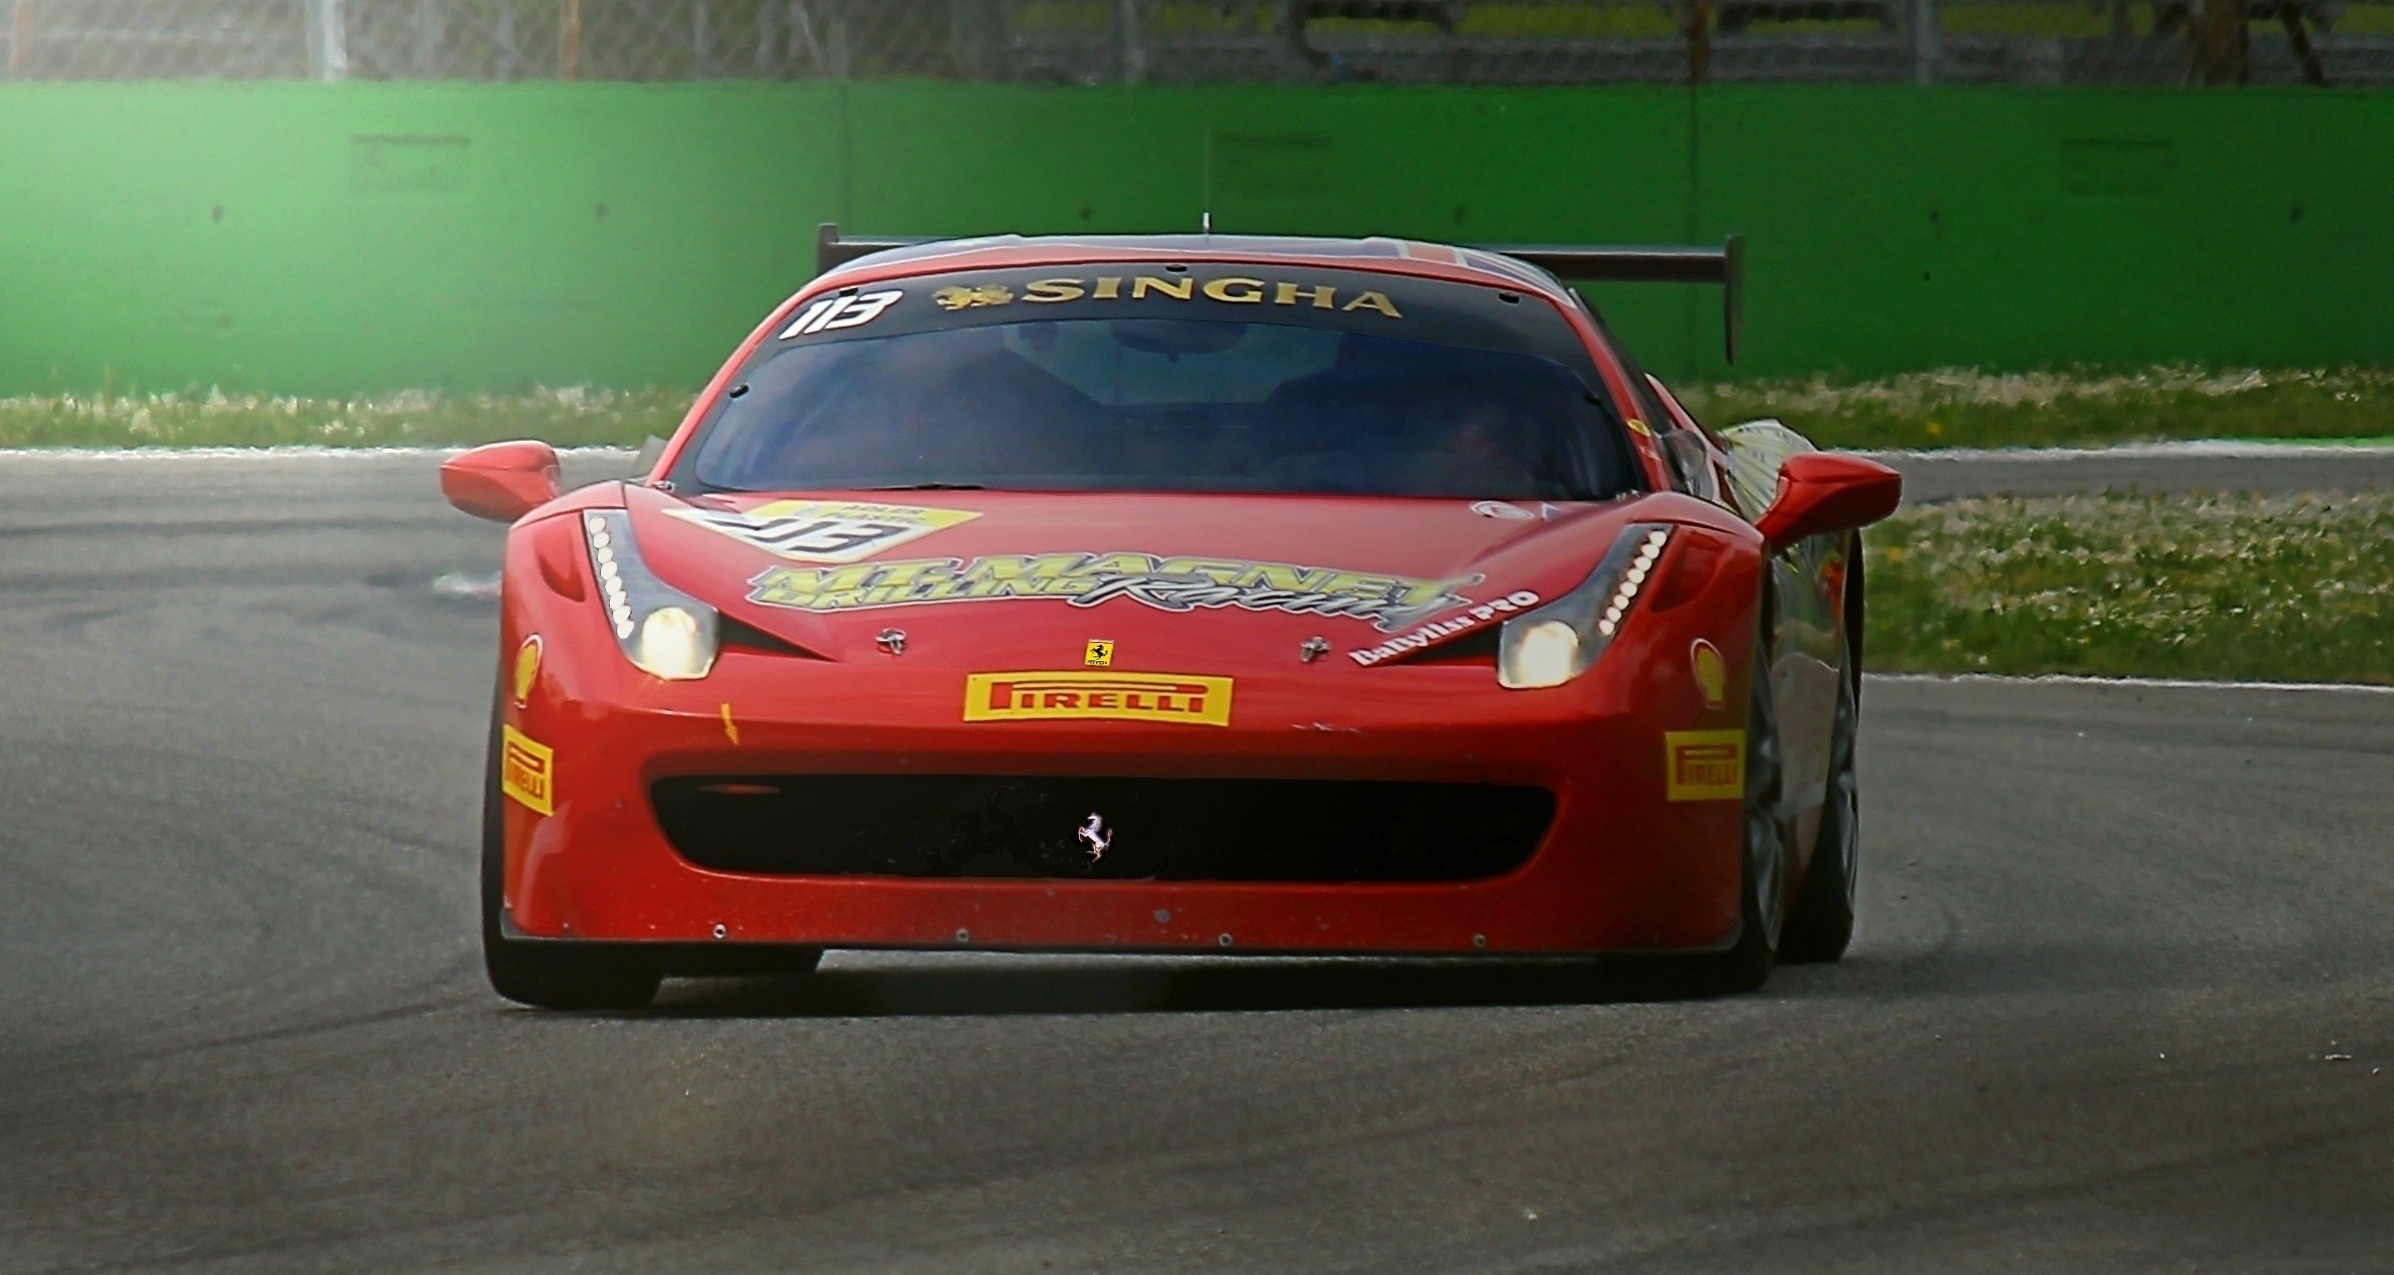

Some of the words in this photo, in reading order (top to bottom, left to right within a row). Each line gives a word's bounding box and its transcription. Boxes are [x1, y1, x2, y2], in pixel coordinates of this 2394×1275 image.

[778, 290, 904, 340] 113
[1021, 277, 1403, 318] SINGHA
[1468, 590, 1540, 621] PRO
[989, 680, 1209, 713] PIRELLI
